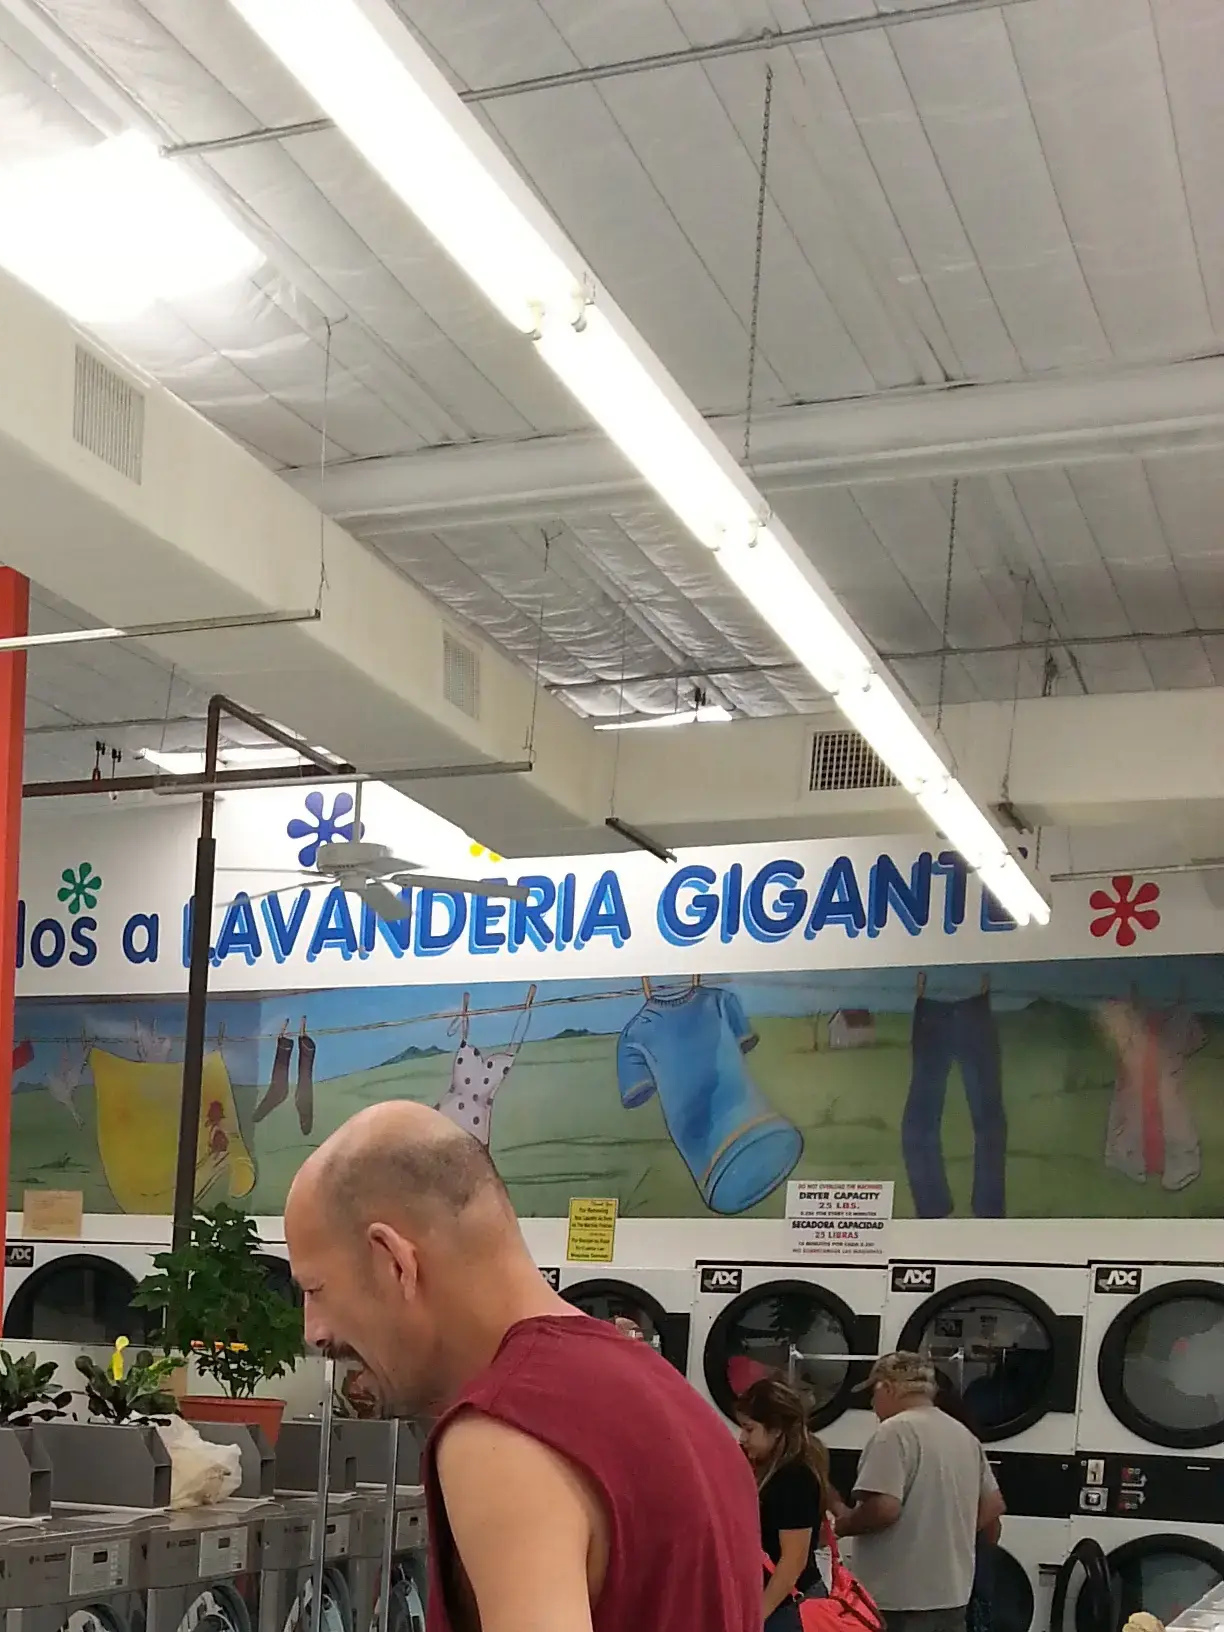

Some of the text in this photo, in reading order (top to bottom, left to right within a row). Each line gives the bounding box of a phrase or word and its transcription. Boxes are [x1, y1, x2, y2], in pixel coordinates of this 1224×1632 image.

[123, 912, 159, 964] a
[799, 1191, 881, 1200] DRYER CAPACITY
[792, 1220, 884, 1230] SECADORA CAPACIDAD
[711, 1271, 739, 1285] ADC
[903, 1269, 932, 1284] ADC
[1107, 1270, 1137, 1286] ADC
